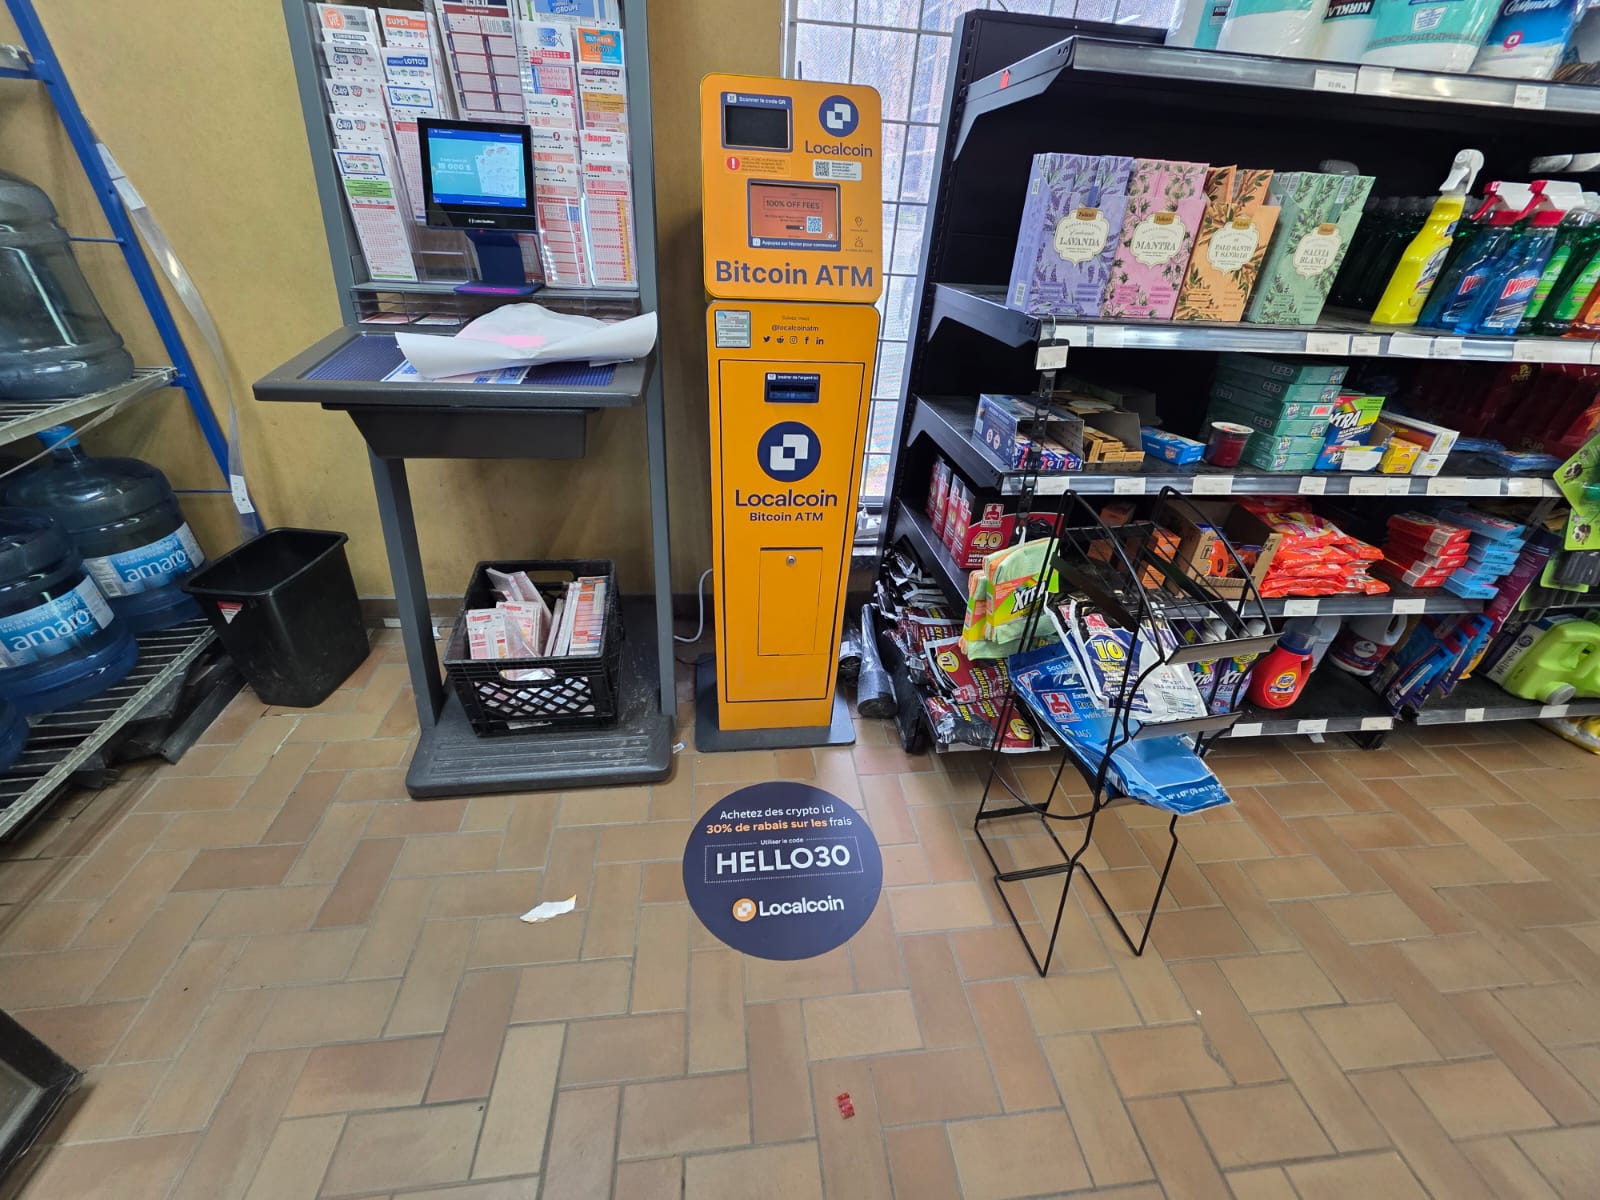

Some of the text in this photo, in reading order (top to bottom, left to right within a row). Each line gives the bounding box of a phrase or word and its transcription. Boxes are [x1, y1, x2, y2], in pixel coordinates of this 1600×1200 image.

[1328, 2, 1371, 17] KIRKLA
[805, 140, 873, 157] Localcoin
[766, 200, 785, 208] 100%
[786, 201, 801, 209] OFF
[1059, 237, 1100, 246] LAVANDA
[1135, 241, 1176, 251] MANTRA
[716, 260, 873, 287] Bitcoin ATM
[772, 324, 819, 332] @localcoinatm
[735, 489, 837, 507] Localcoin
[750, 512, 823, 522] Bitcoin ATM
[971, 531, 1004, 550] 40
[125, 549, 187, 582] amaro
[9, 609, 91, 650] amaro
[1091, 640, 1125, 660] 10
[720, 804, 834, 820] Achetez des crypto ici
[706, 817, 853, 834] 30% de rabais sur les frais
[760, 838, 782, 846] Utiliser
[716, 845, 850, 875] HELLO30
[759, 895, 845, 917] Localcoin
